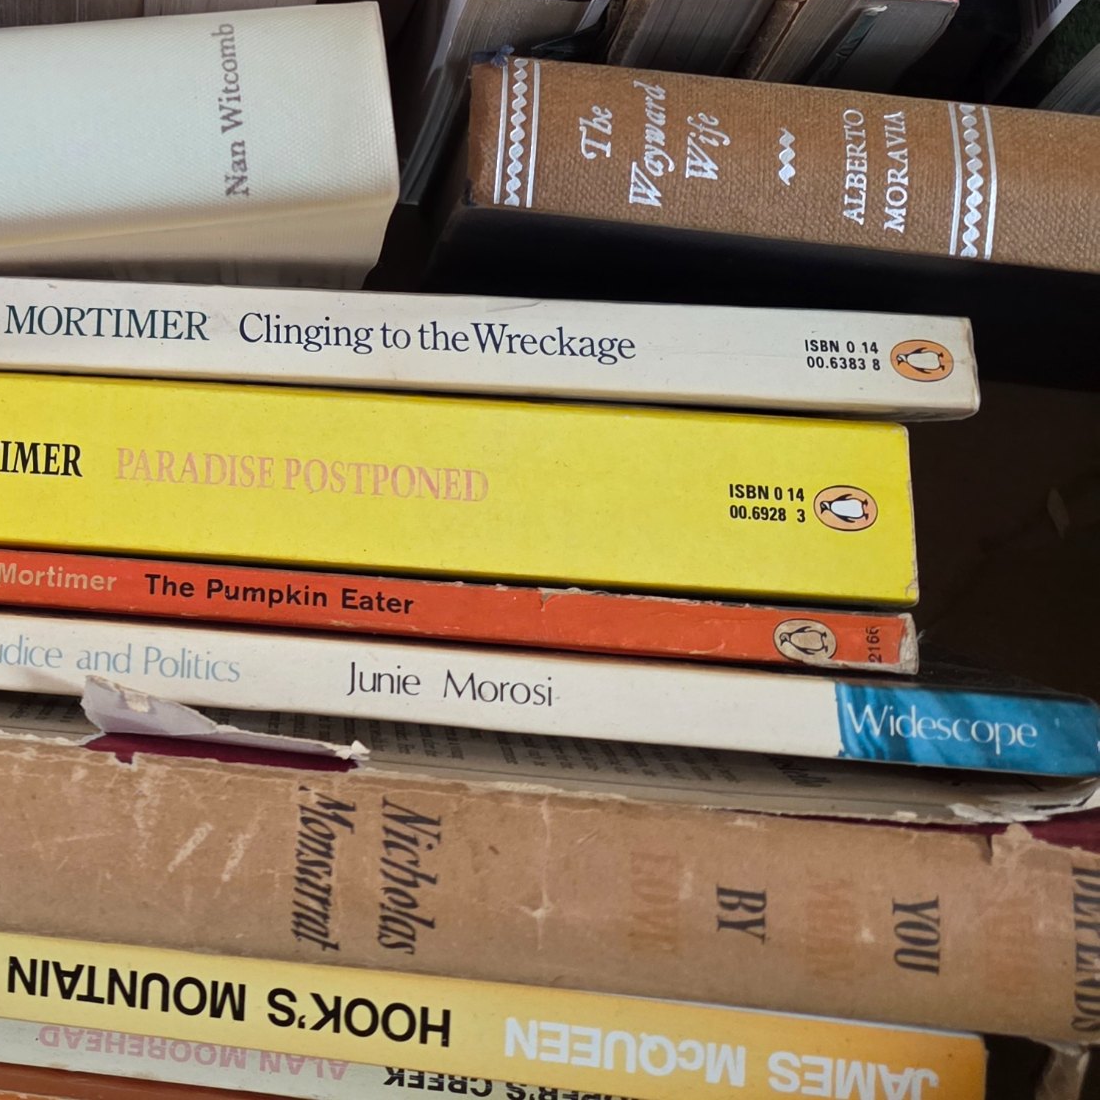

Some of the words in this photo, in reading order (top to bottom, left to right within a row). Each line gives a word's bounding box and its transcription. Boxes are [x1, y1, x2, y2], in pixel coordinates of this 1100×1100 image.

[211, 23, 243, 134] Witcomb
[580, 105, 612, 160] The
[629, 80, 675, 209] Wayward
[685, 112, 730, 181] Wife
[225, 140, 249, 196] Nan
[842, 108, 865, 225] ALBERTO
[884, 111, 906, 234] MORAVIA
[4, 304, 210, 342] MORTIMER
[239, 312, 373, 357] Clinging
[380, 324, 412, 350] to
[805, 339, 839, 353] ISBN
[807, 356, 866, 370] 00.6383
[116, 447, 275, 488] PARADISE
[283, 458, 489, 503] POSTPONED
[729, 484, 769, 500] ISBN
[730, 505, 786, 522] 00.6928
[144, 573, 195, 599] The
[206, 578, 328, 609] Pumpkin
[340, 589, 415, 615] Eater
[76, 644, 132, 675] and
[143, 646, 241, 683] Politics
[347, 662, 421, 697] Junie
[444, 669, 553, 706] Morosi
[845, 703, 1038, 753] Widescope
[291, 786, 356, 951] Monsarrat
[378, 797, 441, 955] Nicholas
[716, 884, 768, 944] BY
[892, 897, 941, 976] YOU
[7, 955, 246, 1022] MOUNTAIN
[268, 987, 452, 1047] HOOK'S
[38, 1025, 247, 1069] MOOREHEAD
[258, 1051, 350, 1081] ALAN
[503, 1017, 747, 1089] McQUEEN
[768, 1050, 940, 1100] JAMES
